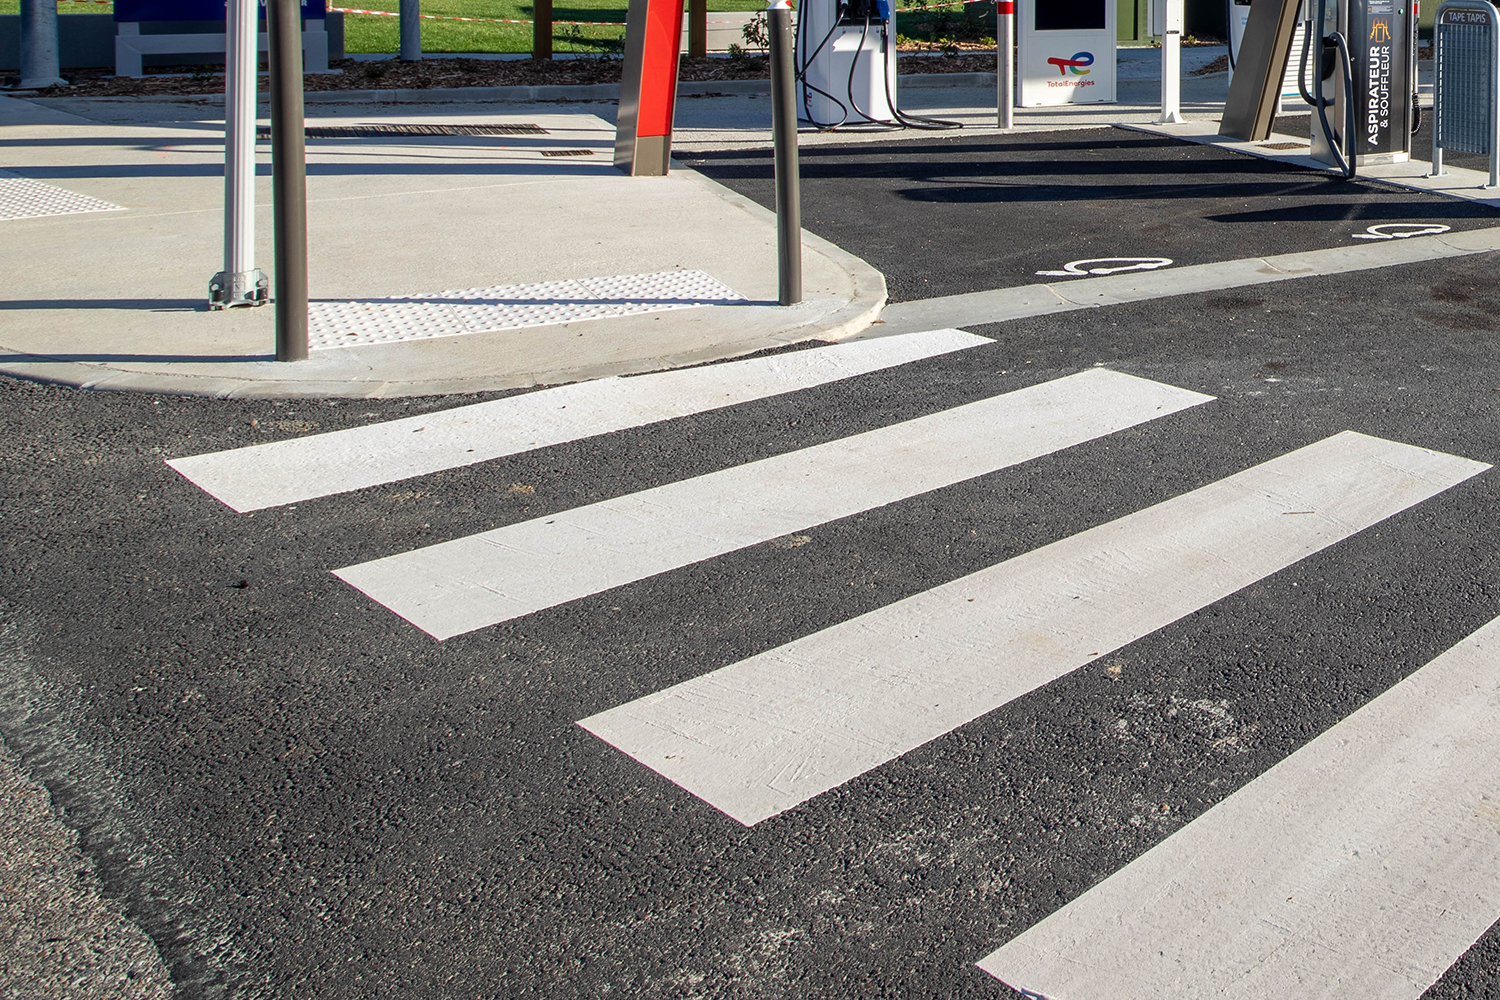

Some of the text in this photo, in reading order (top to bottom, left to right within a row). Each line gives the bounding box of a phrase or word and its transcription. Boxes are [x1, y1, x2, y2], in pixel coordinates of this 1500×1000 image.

[1448, 12, 1486, 24] TAPE TAPIS
[1047, 79, 1095, 88] TotalEnergies
[1367, 46, 1380, 146] ASPIRATEUR
[1380, 46, 1390, 128] & SOUFFLEUR
